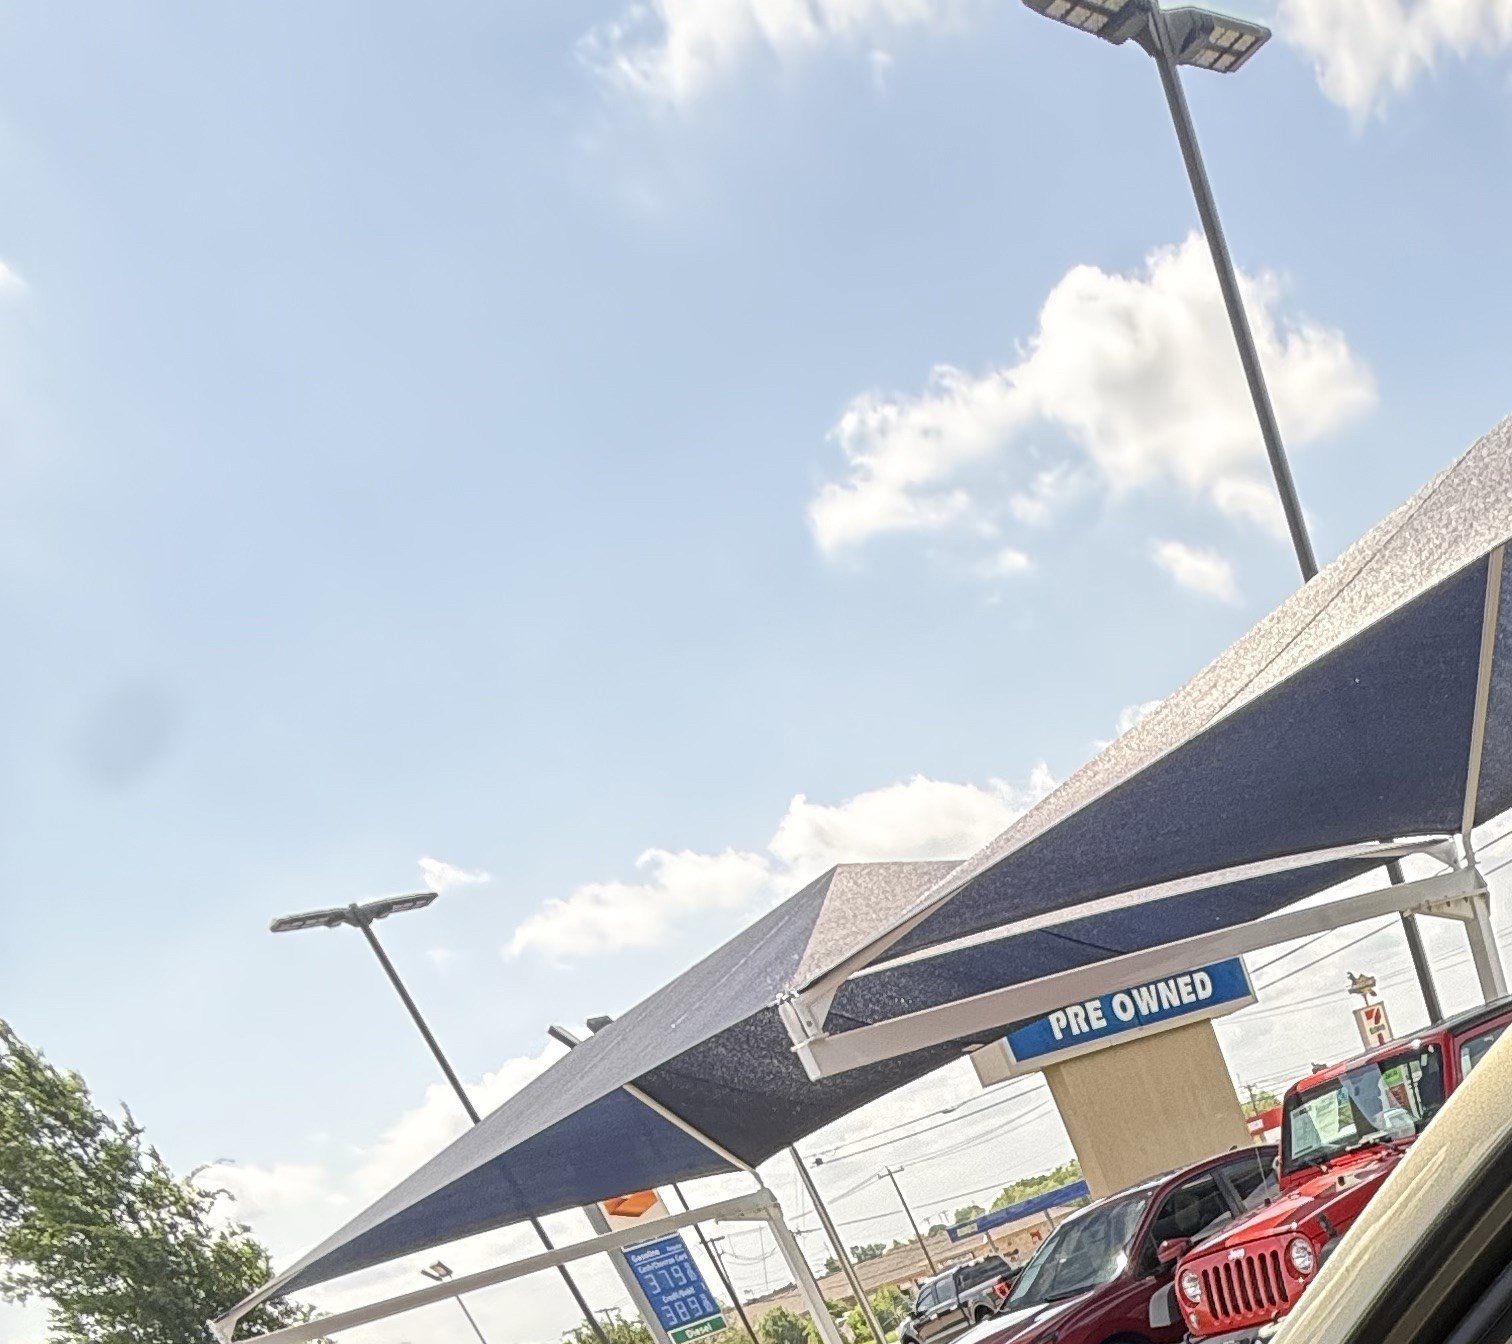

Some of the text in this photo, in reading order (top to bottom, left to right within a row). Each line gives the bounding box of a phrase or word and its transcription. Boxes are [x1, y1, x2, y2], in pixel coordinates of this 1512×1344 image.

[1047, 970, 1214, 1041] PRE OWNED
[685, 1322, 713, 1339] Diesel
